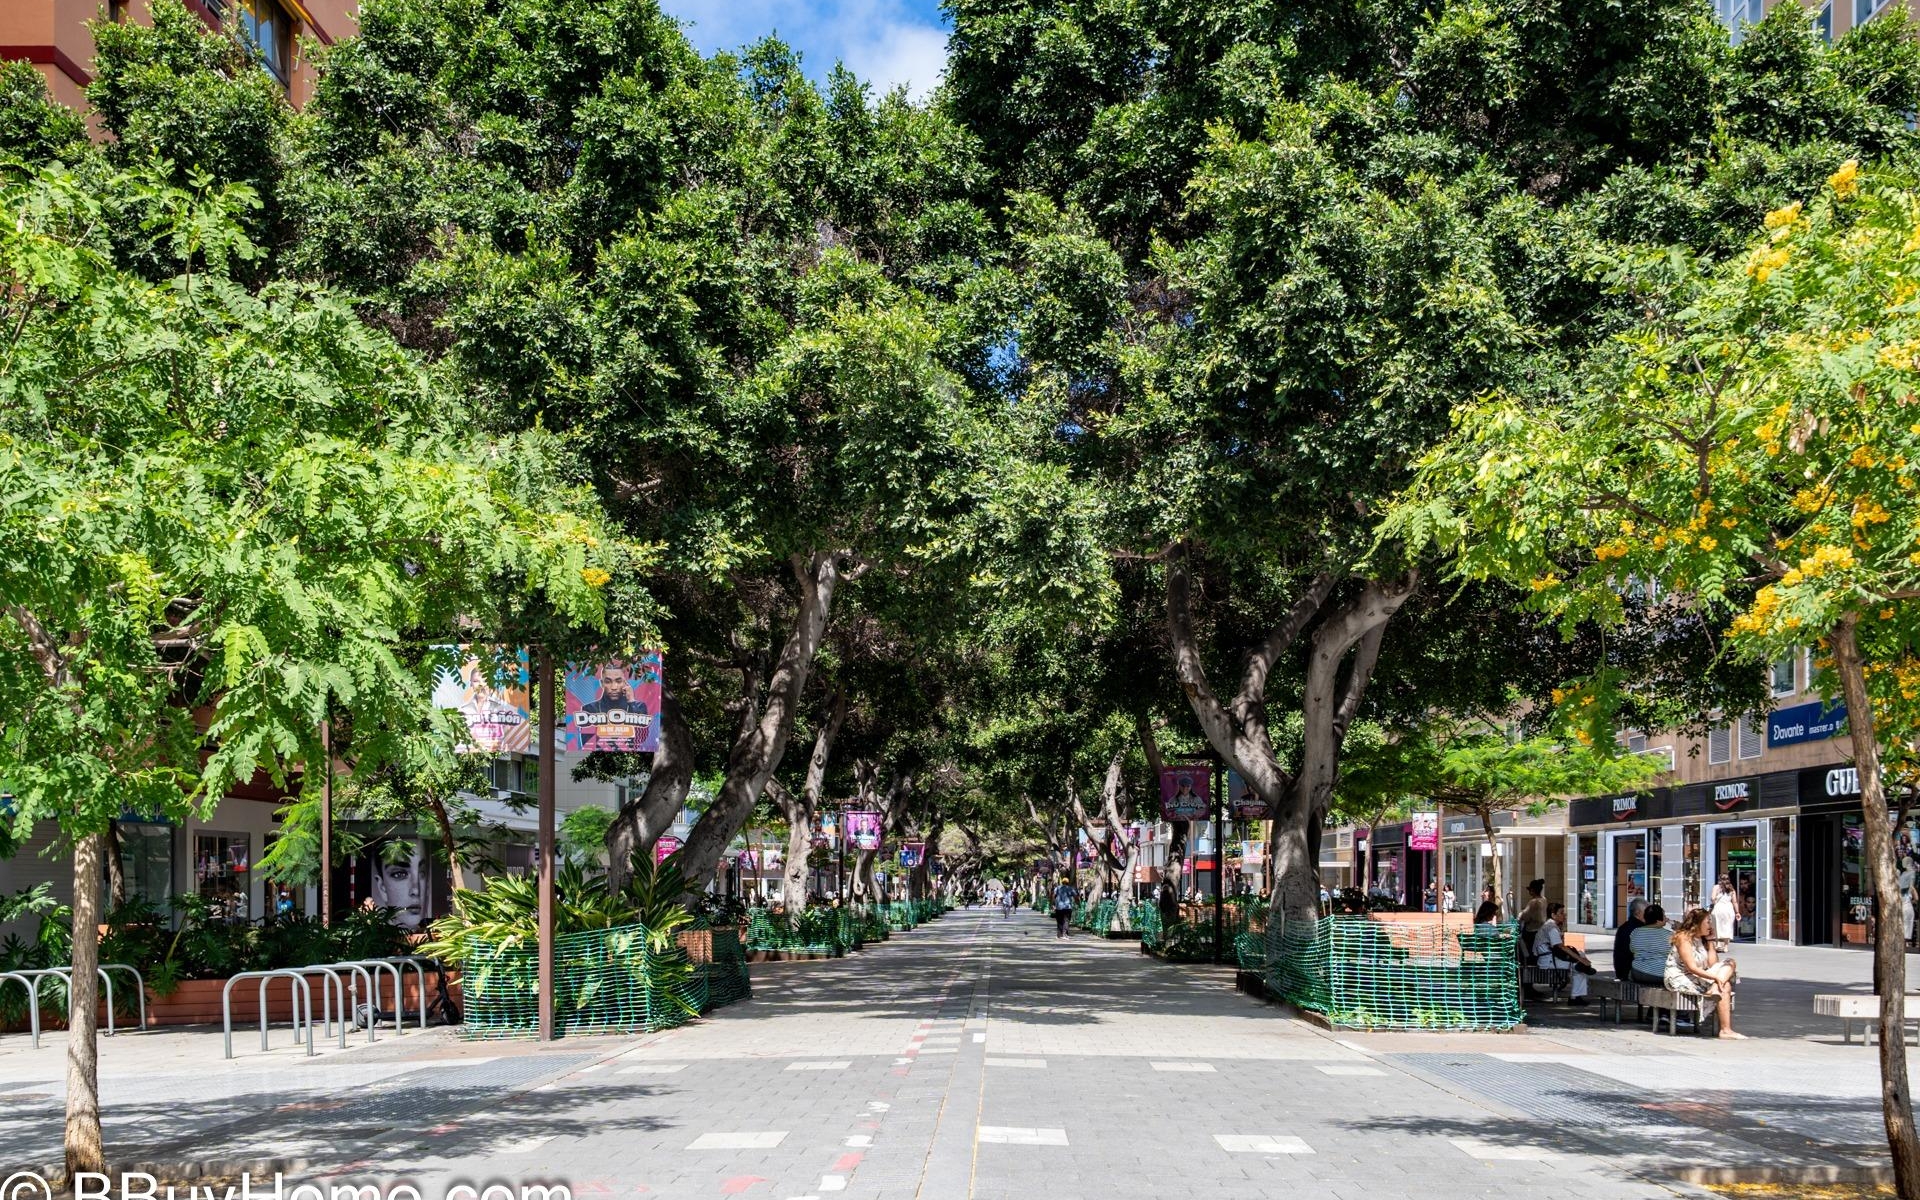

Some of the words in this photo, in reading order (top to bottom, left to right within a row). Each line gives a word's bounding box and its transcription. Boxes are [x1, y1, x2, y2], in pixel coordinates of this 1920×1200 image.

[575, 712, 607, 726] Don
[608, 709, 652, 726] Omar
[1773, 723, 1805, 741] Davante
[1825, 767, 1862, 797] GUE
[1715, 783, 1750, 801] PRIMOR
[1613, 797, 1637, 812] PRIMOR
